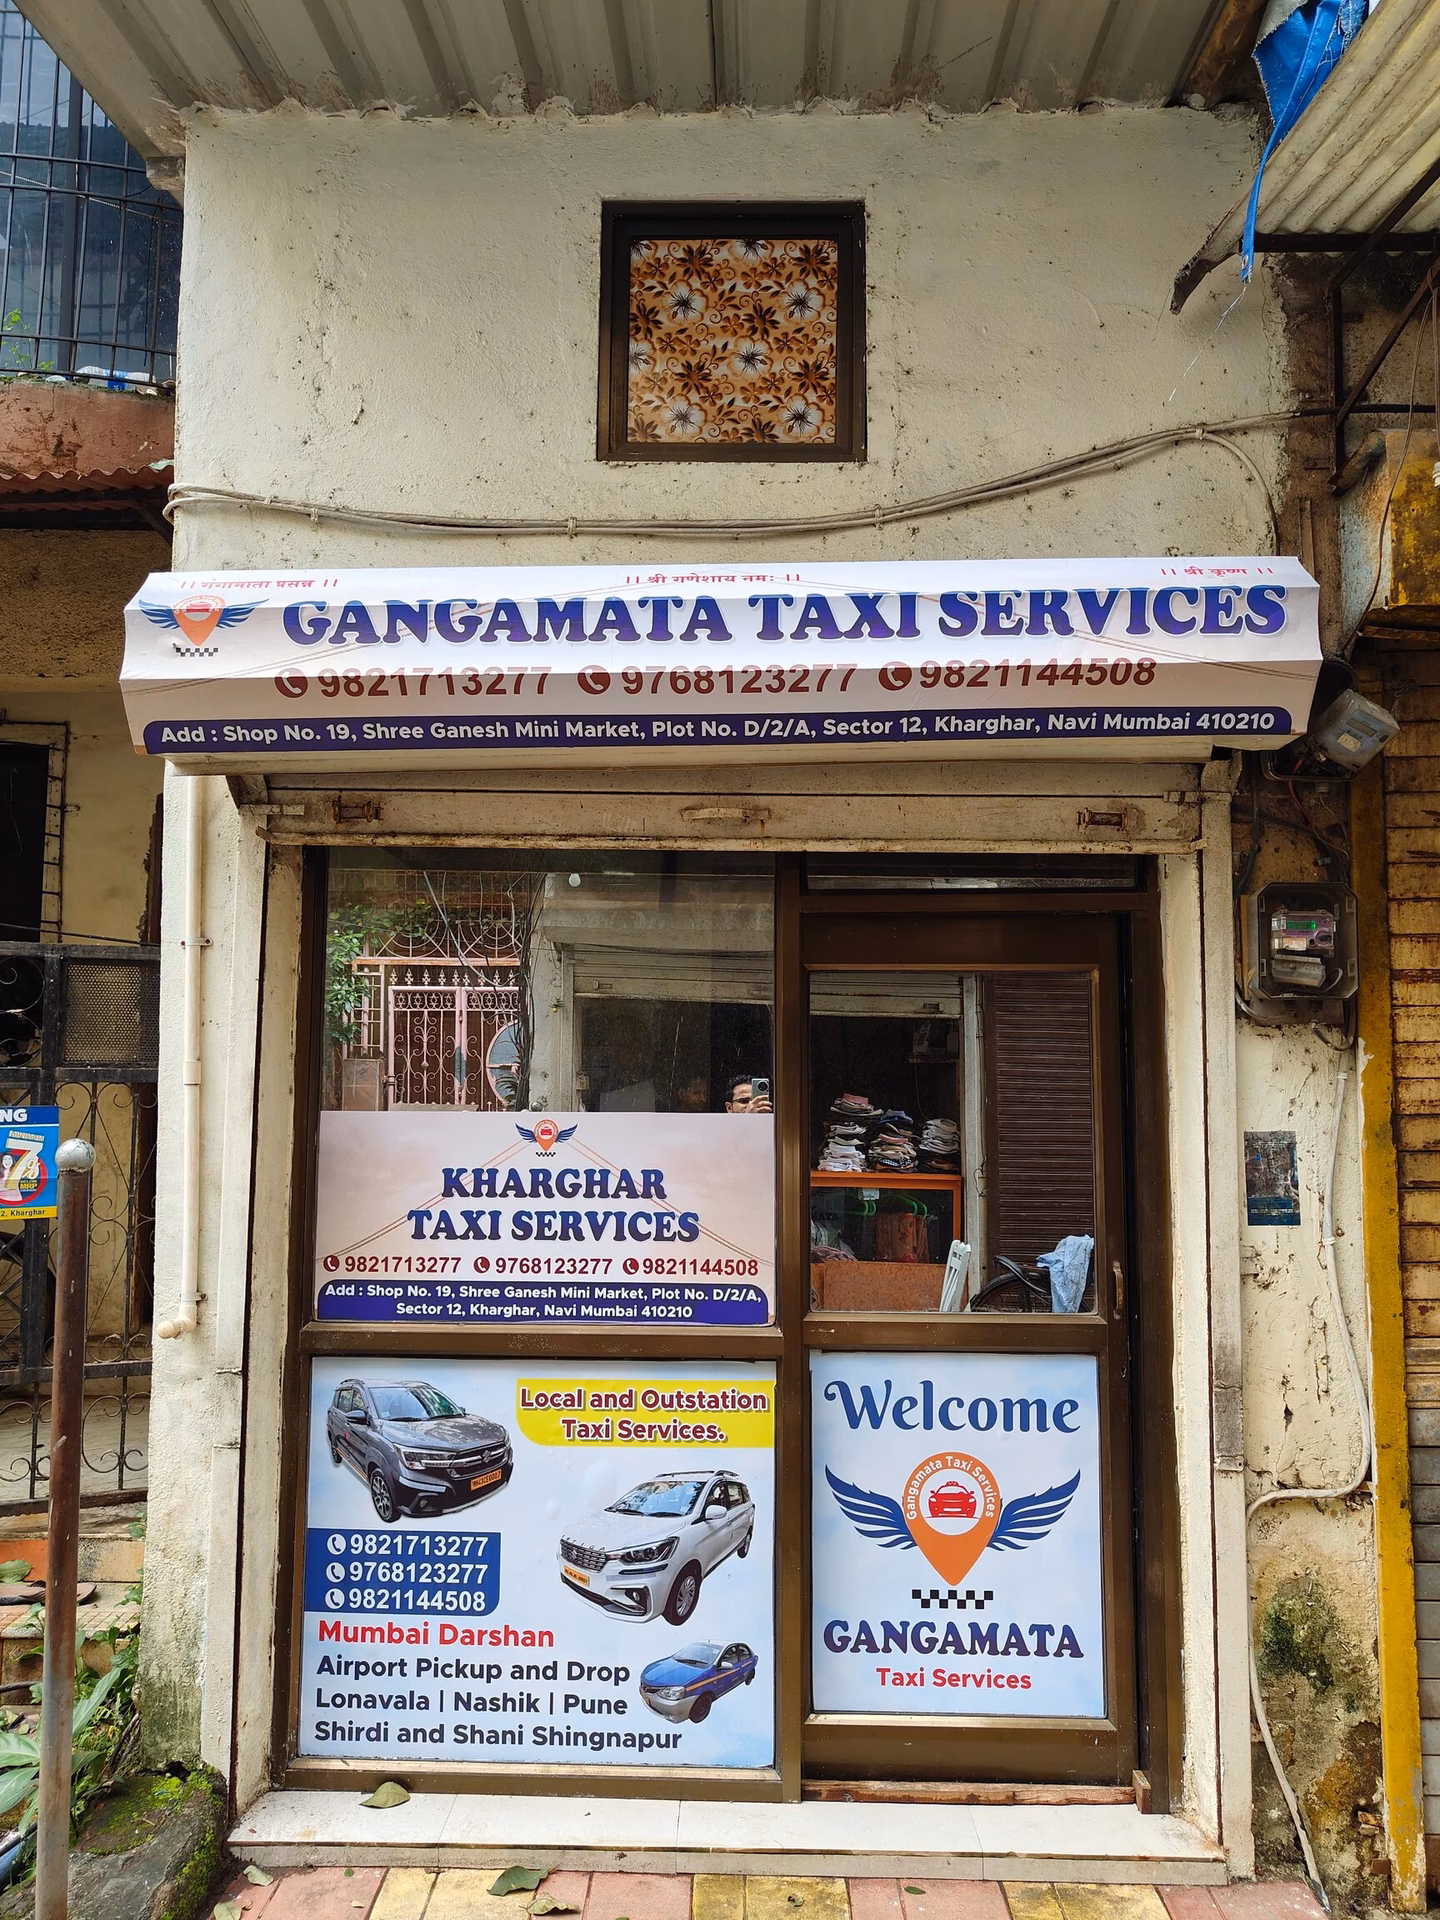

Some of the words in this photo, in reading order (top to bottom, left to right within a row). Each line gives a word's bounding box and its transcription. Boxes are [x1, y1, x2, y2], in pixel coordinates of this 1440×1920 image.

[647, 574, 667, 583] श्री
[672, 572, 737, 583] गणेशाय
[1184, 566, 1204, 575] श्री
[1208, 568, 1247, 577] कृष्ण
[201, 579, 272, 589] गंगामाता
[282, 596, 733, 645] GANGAMATA
[748, 592, 921, 641] TAXI
[938, 585, 1287, 637] SERVICES
[317, 667, 551, 697] 9821713277
[622, 664, 857, 694] 9768123277
[919, 658, 1157, 688] 9821144508
[161, 726, 205, 743] Add
[223, 725, 278, 744] Shop
[284, 724, 321, 741] No.
[326, 724, 357, 743] 19,
[363, 723, 424, 739] Shree
[430, 721, 508, 738] Ganesh
[515, 720, 559, 738] Mini
[566, 720, 646, 740] Market,
[652, 720, 695, 738] Plot
[701, 720, 737, 737] No.
[744, 719, 816, 739] D/2/A,
[823, 719, 893, 736] Sector
[899, 717, 928, 735] 12,
[935, 714, 1040, 737] Kharghar,
[1048, 713, 1096, 730] Navi
[1103, 712, 1191, 730] Mumbai
[1195, 713, 1275, 730] 410210
[441, 1167, 667, 1199] KHARGHAR
[10, 1209, 45, 1217] Kharghar
[407, 1209, 502, 1240] TAXI
[511, 1210, 701, 1242] SERVICES
[345, 1256, 462, 1273] 9821713277
[495, 1257, 613, 1274] 9768123277
[642, 1258, 759, 1276] 9821144508
[325, 1284, 355, 1296] Add
[366, 1284, 403, 1299] Shop
[407, 1285, 432, 1297] No.
[436, 1286, 455, 1299] 19,
[460, 1286, 500, 1298] Shree
[504, 1286, 557, 1298] Ganesh
[560, 1286, 590, 1299] Mini
[594, 1287, 648, 1301] Market,
[652, 1288, 680, 1300] Plot
[684, 1289, 708, 1301] No.
[712, 1288, 761, 1303] D/2/A,
[396, 1303, 443, 1315] Sector
[446, 1304, 466, 1317] 12,
[470, 1304, 540, 1318] Kharghar,
[544, 1304, 577, 1316] Navi
[581, 1304, 638, 1317] Mumbai
[641, 1306, 692, 1318] 410210
[520, 1388, 583, 1411] Local
[589, 1390, 638, 1411] and
[640, 1389, 768, 1412] Outstation
[824, 1380, 1081, 1434] Welcome
[562, 1419, 611, 1440] Taxi
[616, 1420, 727, 1441] Services.
[906, 1460, 942, 1520] Gangamata
[945, 1456, 973, 1471] Taxi
[972, 1466, 997, 1518] Services
[350, 1535, 489, 1557] 9821713277
[349, 1562, 488, 1584] 9768123277
[348, 1588, 486, 1612] 9821144508
[318, 1621, 429, 1645] Mumbai
[438, 1623, 555, 1648] Darshan
[823, 1620, 1084, 1658] GANGAMATA
[316, 1656, 408, 1681] Airport
[416, 1657, 502, 1683] Pickup
[510, 1659, 559, 1681] and
[567, 1662, 631, 1686] Drop
[876, 1667, 925, 1687] Taxi
[932, 1667, 1032, 1689] Services
[316, 1688, 428, 1712] Lonavala
[454, 1690, 541, 1714] Nashik
[564, 1694, 628, 1715] Pune
[314, 1720, 389, 1744] Shirdi
[397, 1723, 445, 1745] and
[453, 1723, 524, 1746] Shani
[533, 1726, 682, 1753] Shingnapur
